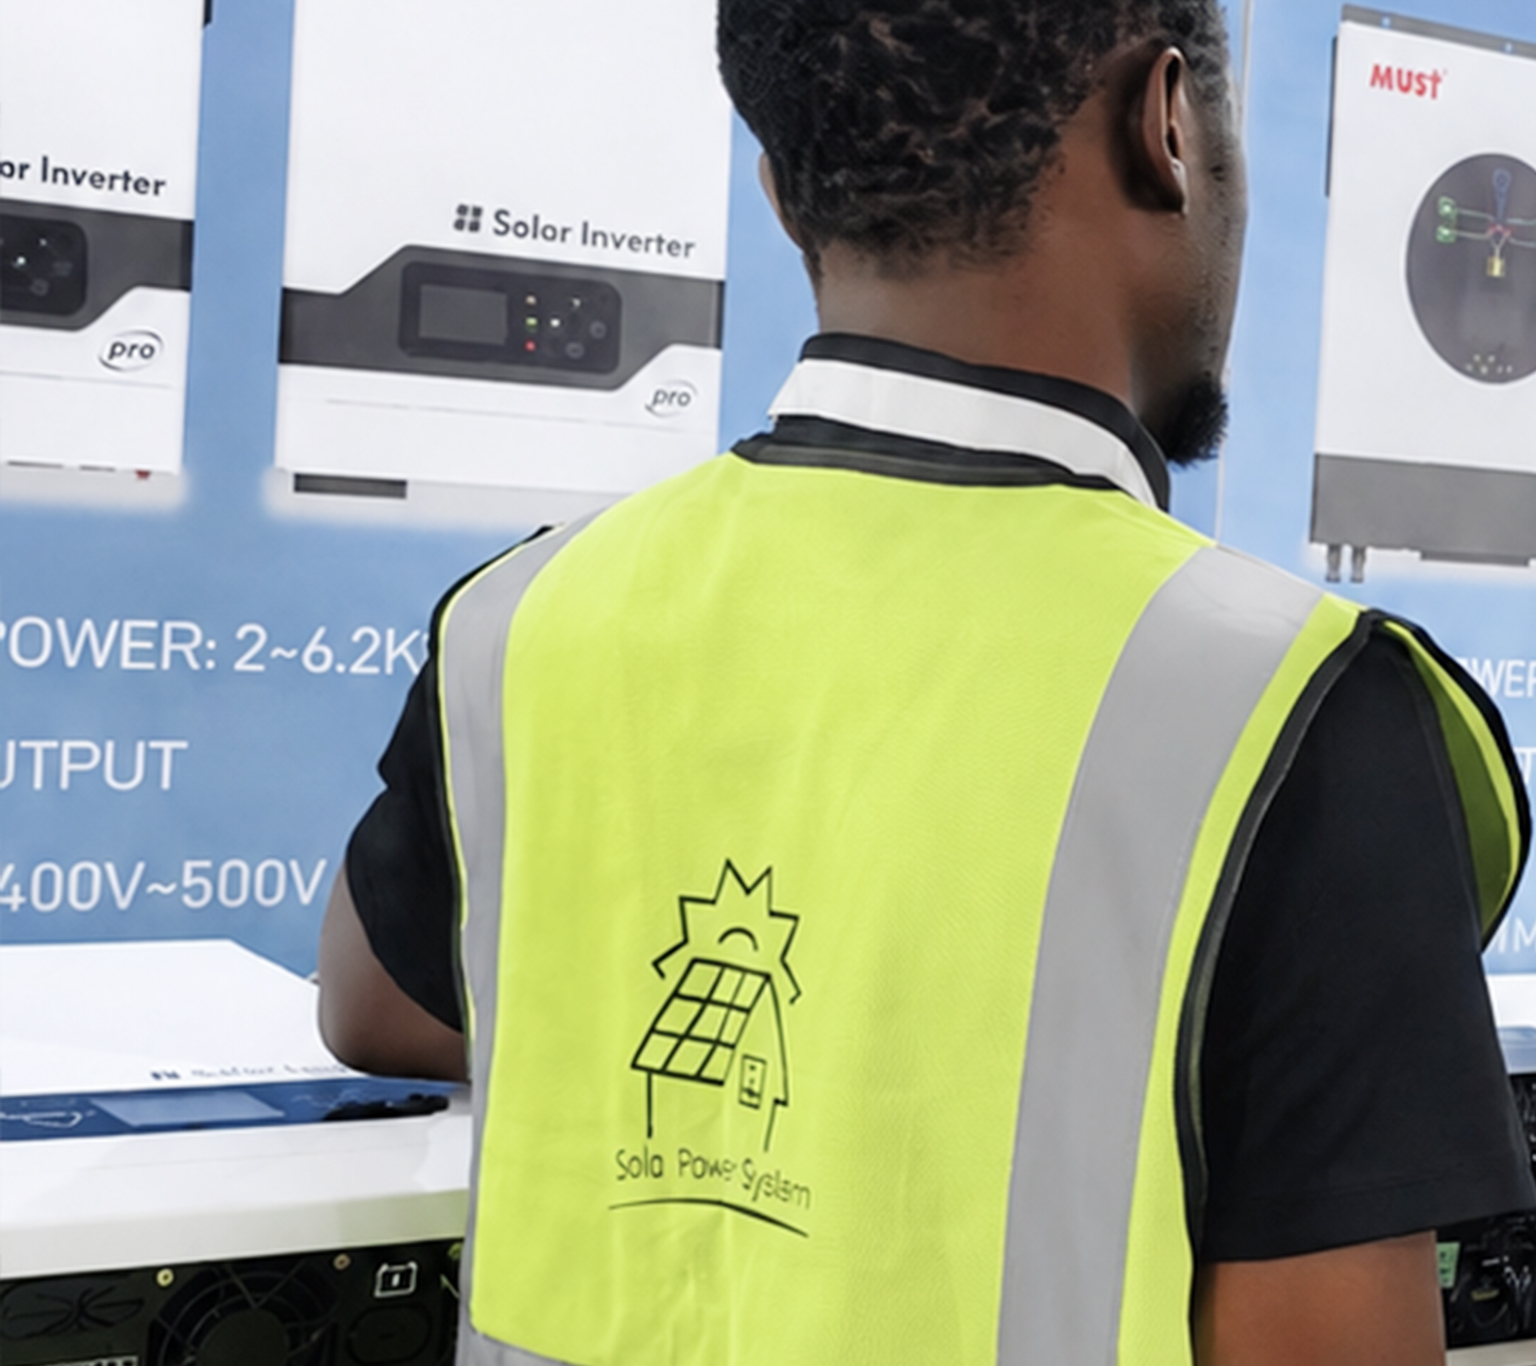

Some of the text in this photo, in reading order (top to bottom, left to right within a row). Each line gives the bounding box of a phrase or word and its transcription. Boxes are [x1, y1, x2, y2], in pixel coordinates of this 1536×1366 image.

[41, 155, 166, 196] Inverter
[581, 221, 696, 257] Inverter
[107, 340, 156, 361] pro
[652, 388, 692, 407] pro
[0, 616, 429, 676] OWER: 2~6.2K
[615, 1143, 664, 1182] Sola
